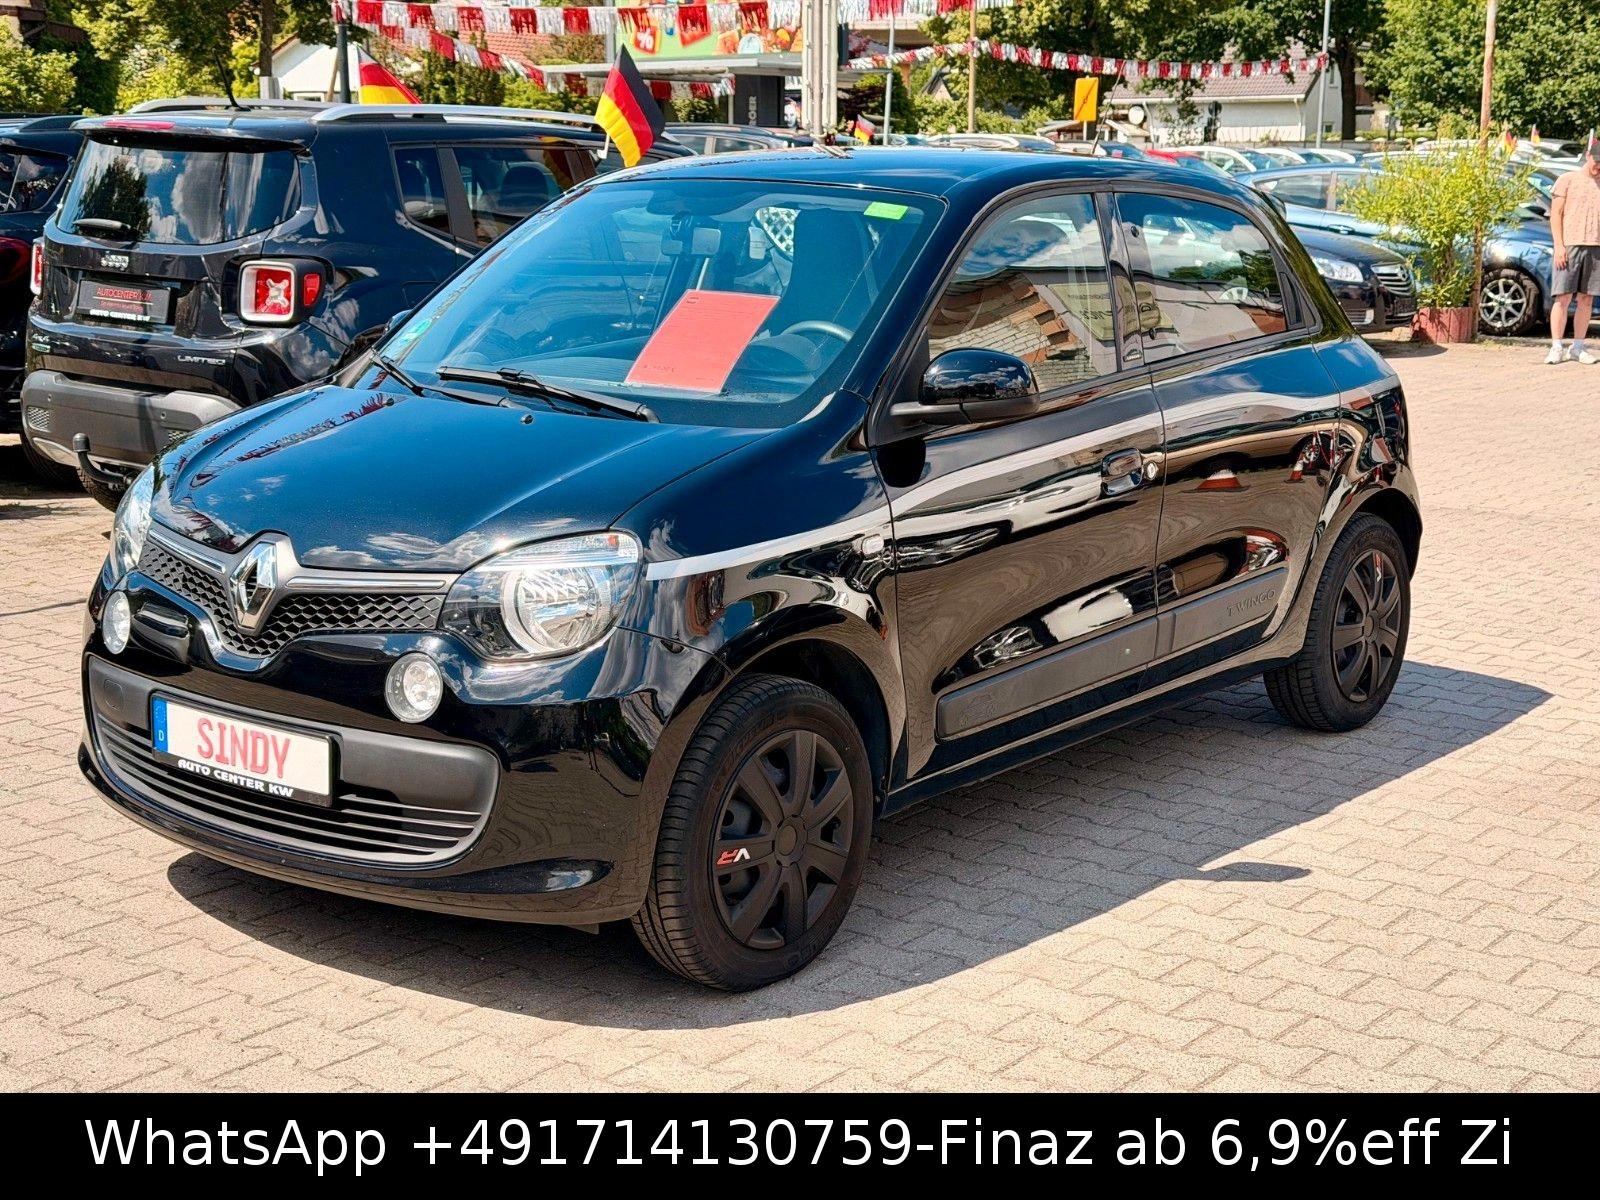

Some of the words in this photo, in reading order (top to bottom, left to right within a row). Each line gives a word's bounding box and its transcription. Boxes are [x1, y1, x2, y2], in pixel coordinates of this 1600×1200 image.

[177, 355, 226, 366] LIMITED
[1226, 589, 1276, 617] TWINGO
[158, 729, 165, 742] D
[197, 717, 291, 779] SINDY
[177, 758, 211, 776] AUTO
[214, 769, 265, 792] CENTER
[268, 783, 294, 798] KW
